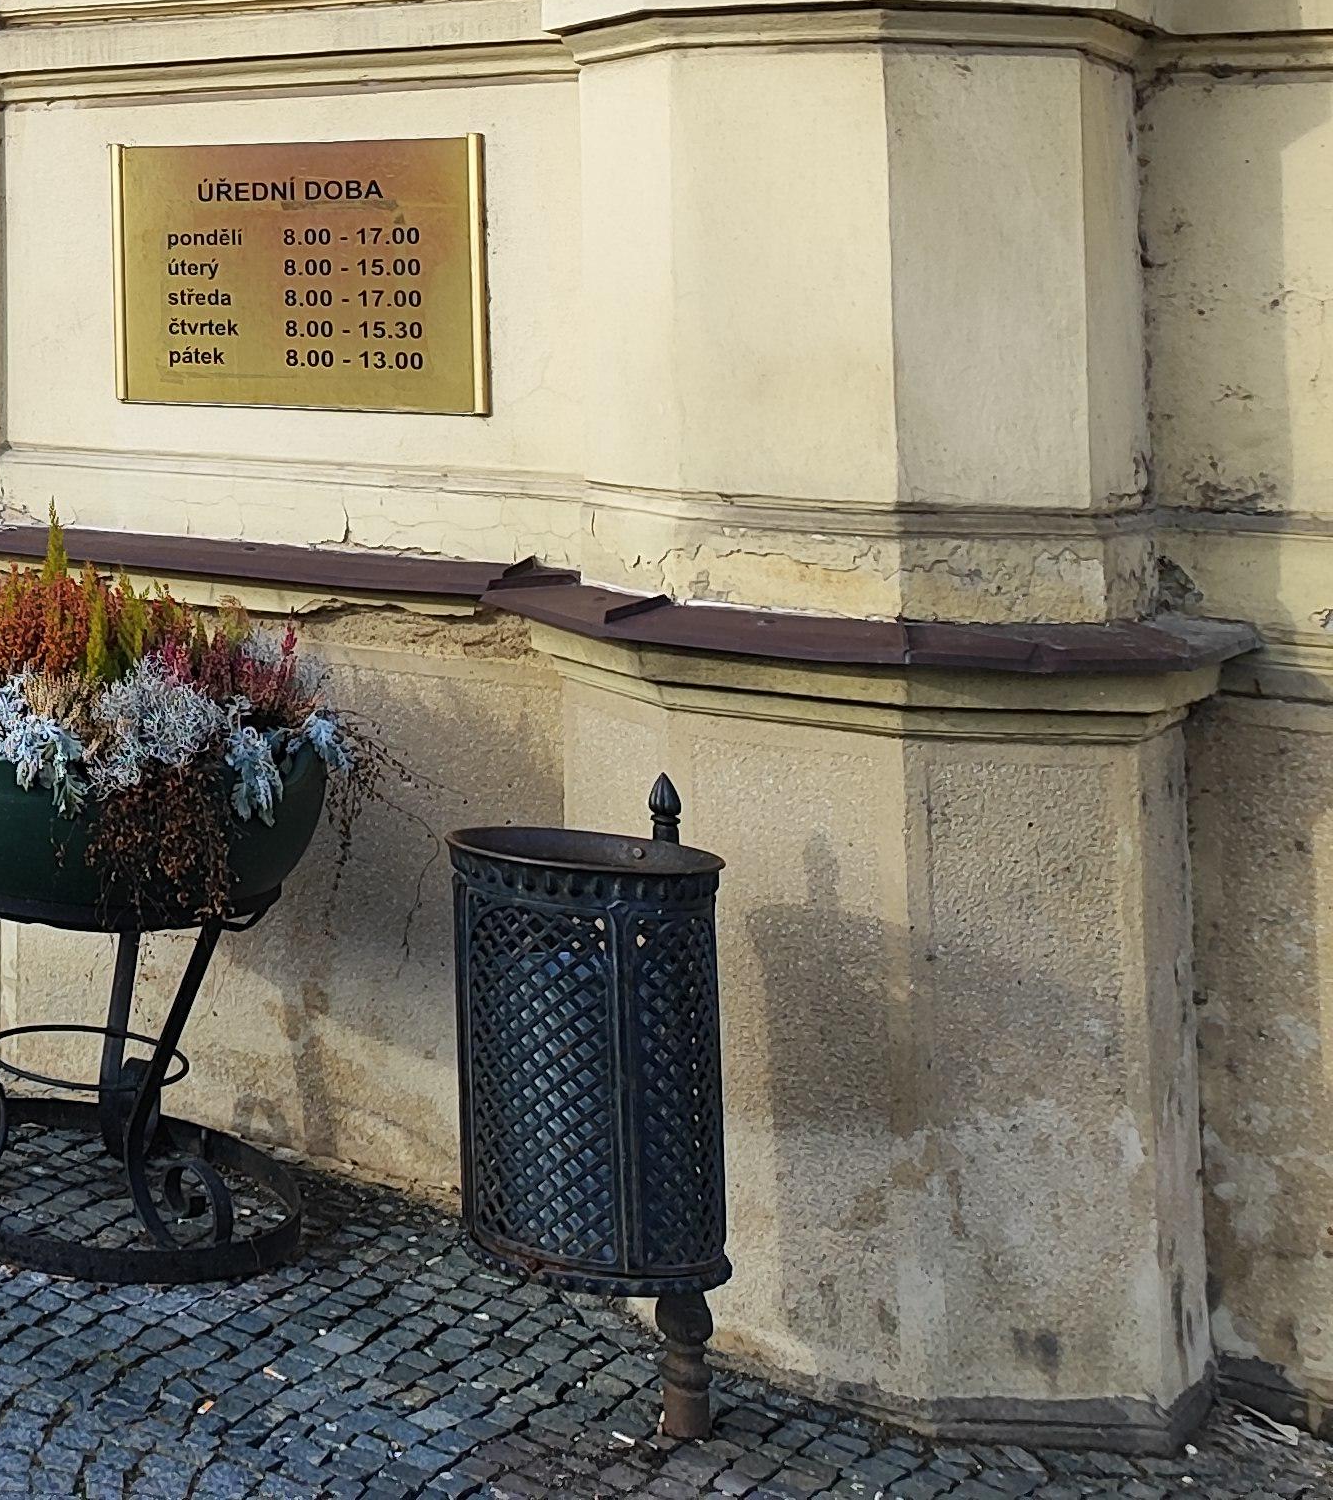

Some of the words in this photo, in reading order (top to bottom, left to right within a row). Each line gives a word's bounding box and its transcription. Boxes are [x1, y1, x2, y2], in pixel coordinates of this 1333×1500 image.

[197, 176, 295, 203] ÚŘEDNÍ
[304, 179, 384, 200] DOBA
[167, 228, 242, 250] pondělí
[283, 228, 331, 246] 8.00
[356, 227, 420, 245] 17.00
[168, 258, 219, 280] úterý
[284, 258, 332, 276] 8.00
[357, 258, 421, 276] 15.00
[168, 288, 232, 306] středa
[284, 289, 333, 307] 8.00
[357, 289, 422, 308] 17.00
[168, 317, 239, 336] čtvrtek
[285, 319, 334, 338] 8.00
[358, 320, 423, 339] 15.30
[169, 345, 225, 368] pátek
[285, 349, 334, 368] 8.00
[359, 350, 424, 370] 13.00
